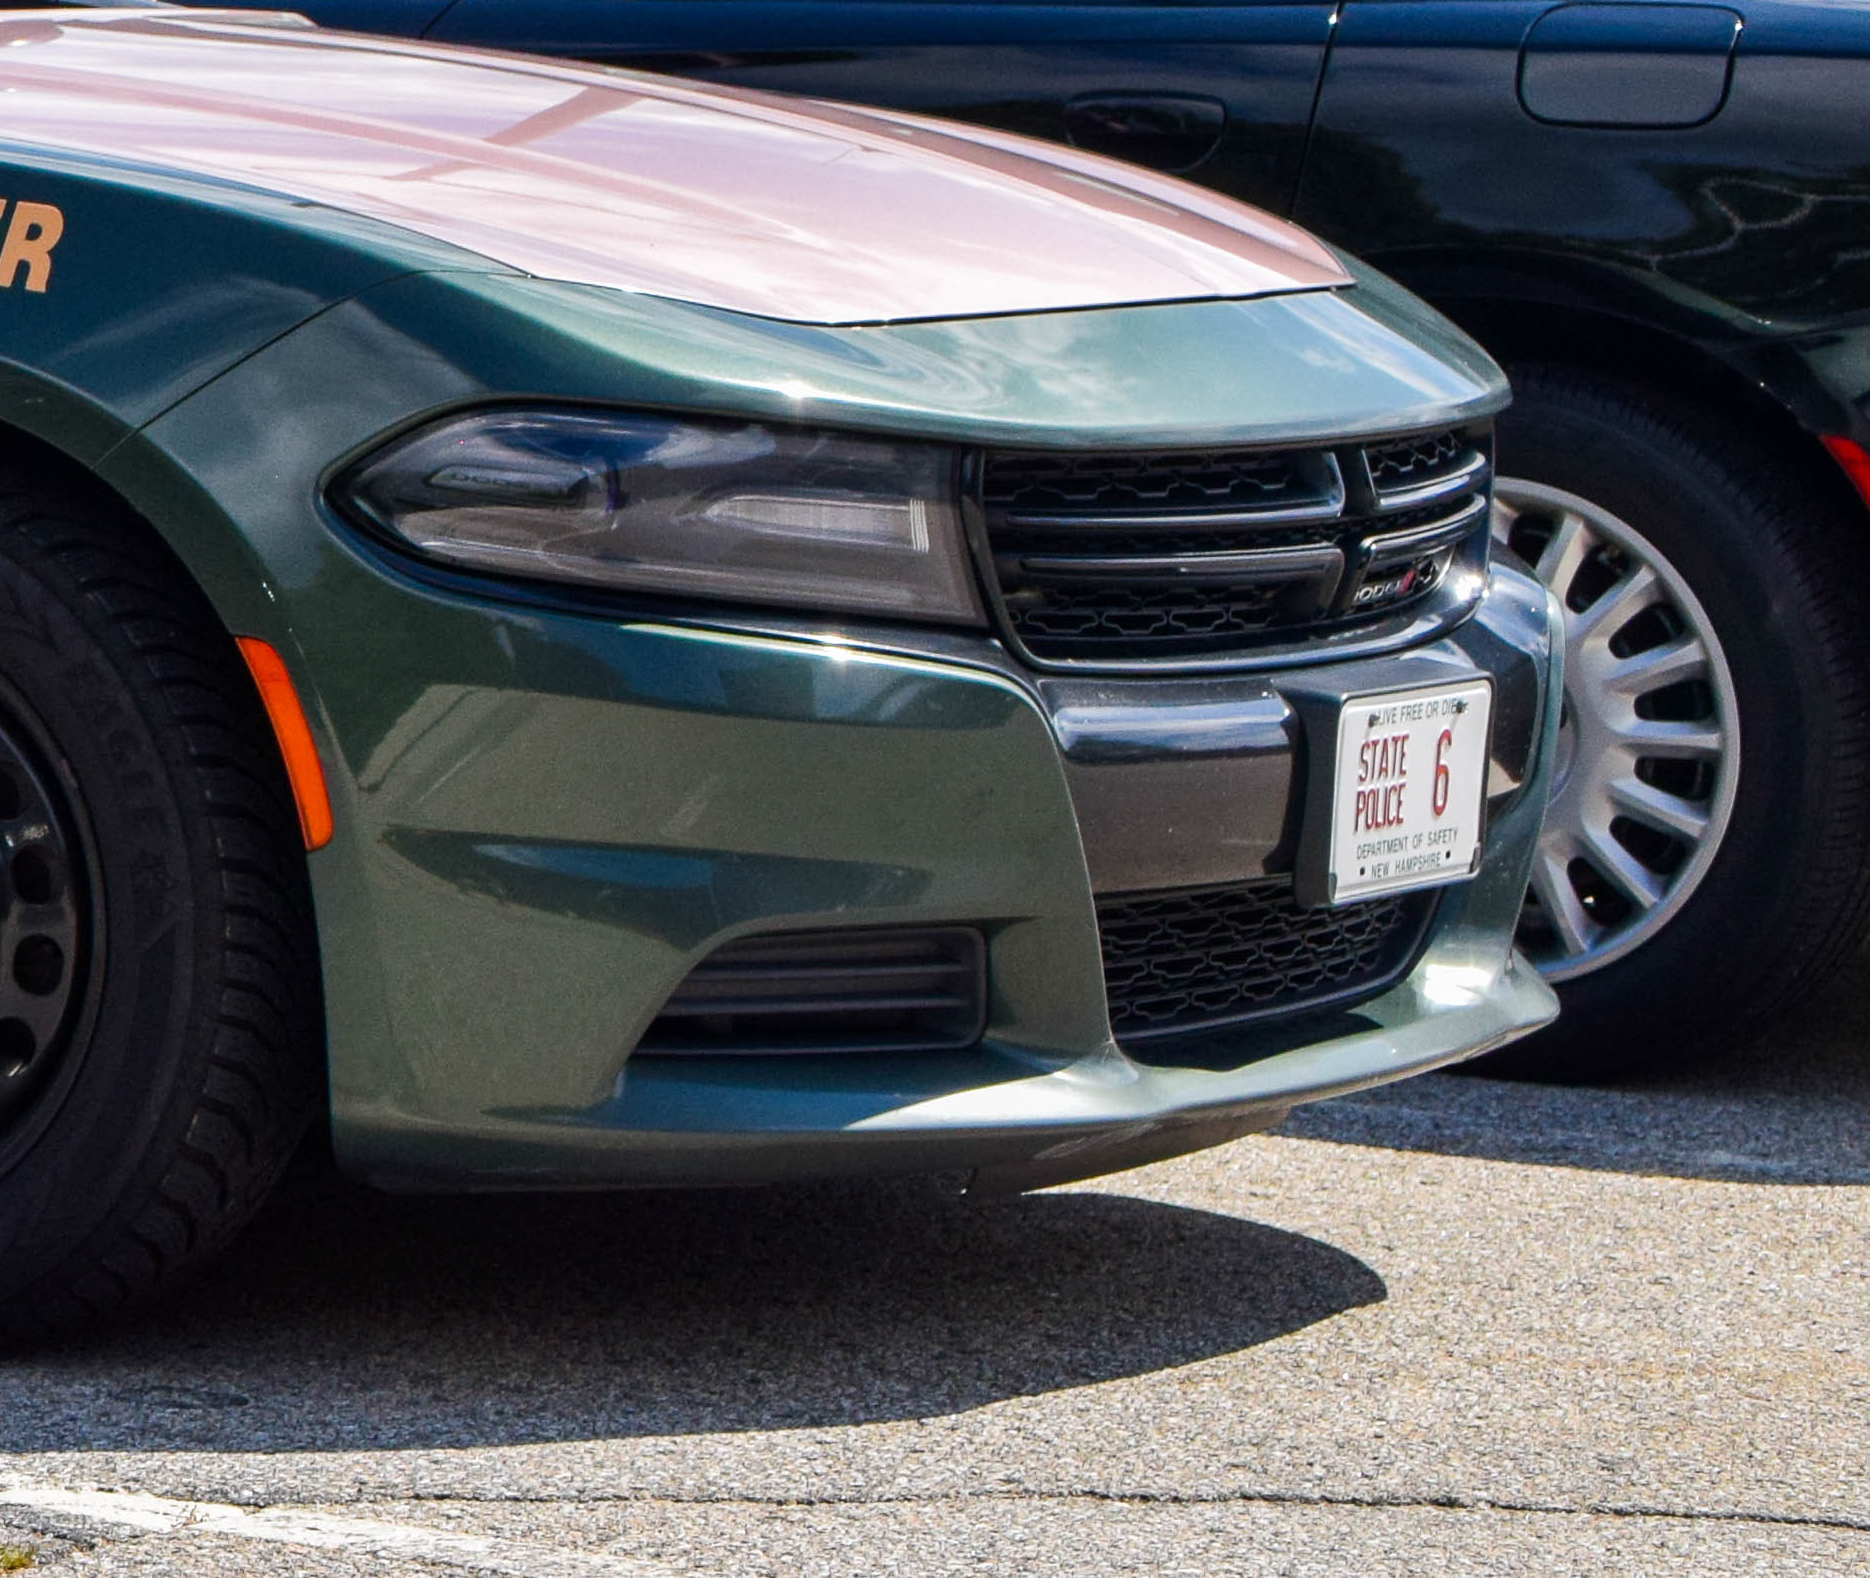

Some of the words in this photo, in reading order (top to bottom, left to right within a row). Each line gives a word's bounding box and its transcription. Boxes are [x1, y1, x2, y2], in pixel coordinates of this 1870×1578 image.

[1400, 703, 1424, 722] FREE
[1426, 701, 1438, 719] OR
[1359, 734, 1410, 782] STATE
[1433, 729, 1452, 816] 6
[1354, 783, 1406, 833] POLICE
[1356, 836, 1409, 860] DEPARTMENT
[1412, 834, 1423, 849] OF
[1427, 827, 1458, 846] SAFETY
[1371, 860, 1389, 878] NEW
[1395, 852, 1442, 874] HAMPSHIRE
